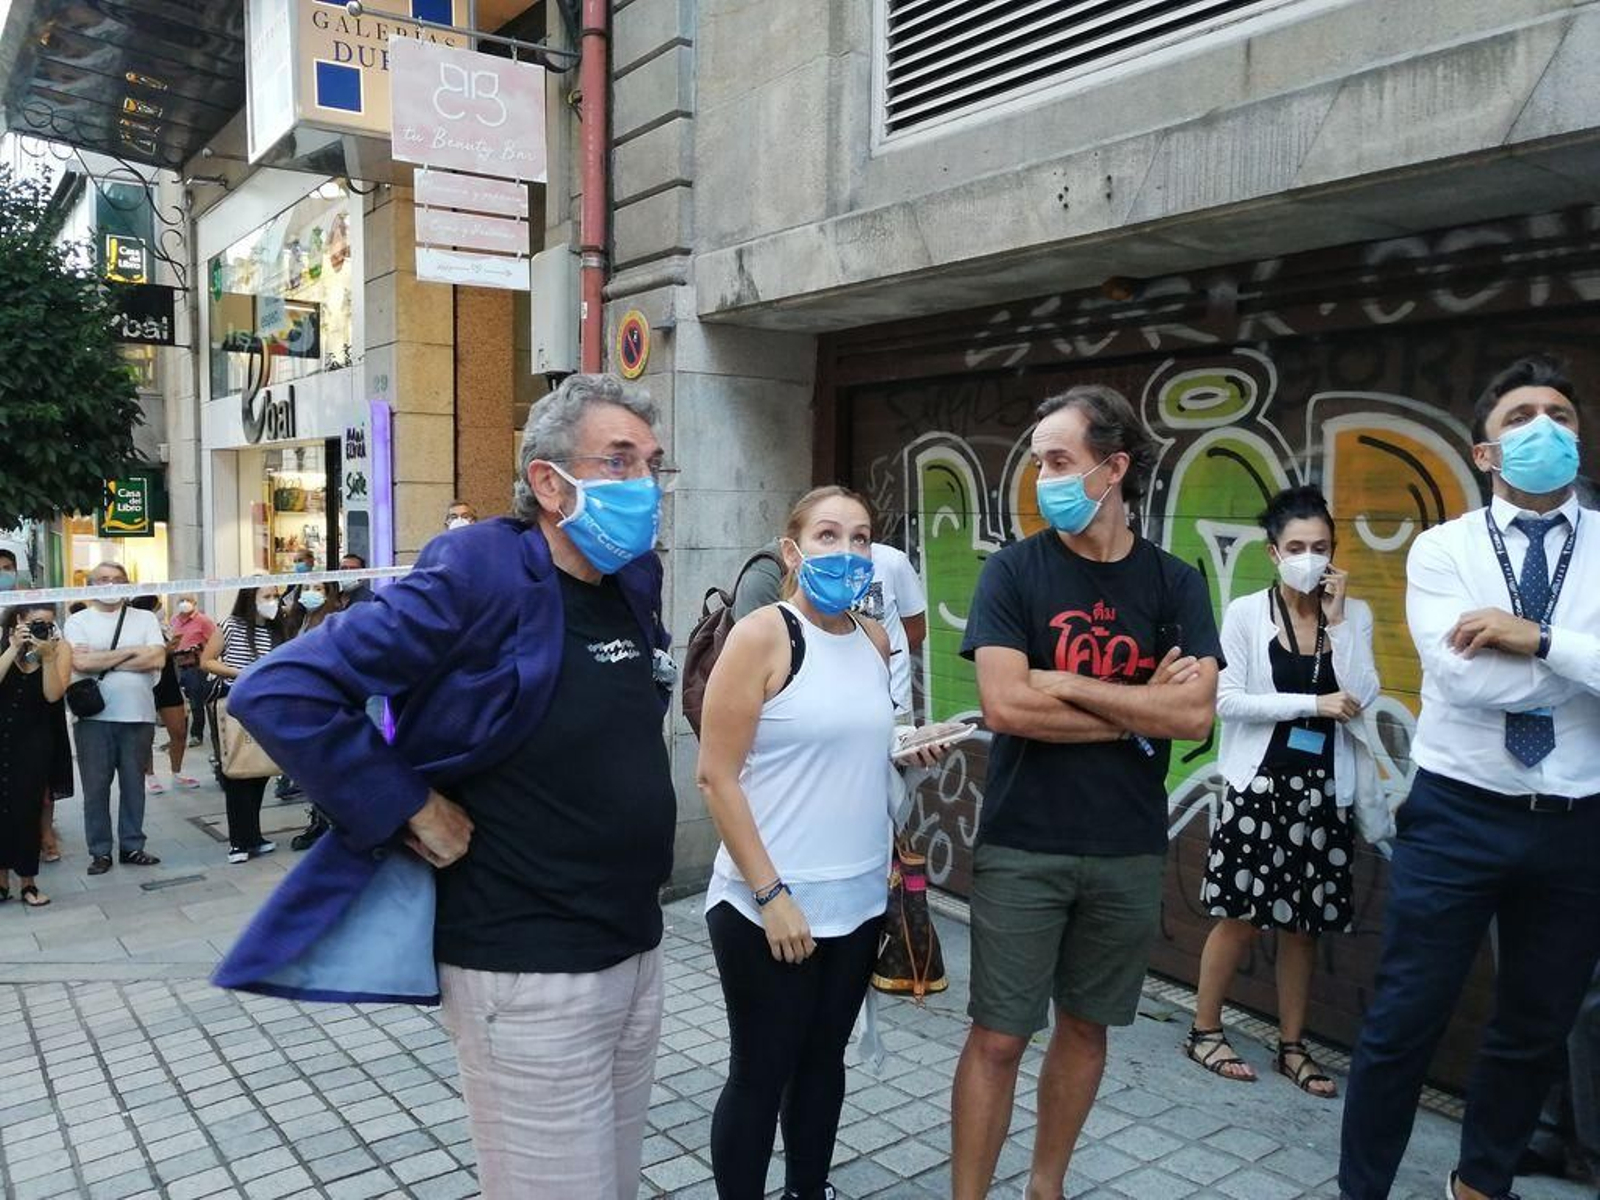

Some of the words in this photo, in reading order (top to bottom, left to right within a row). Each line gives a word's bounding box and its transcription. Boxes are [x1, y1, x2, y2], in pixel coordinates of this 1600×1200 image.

[119, 246, 140, 256] Casa
[118, 259, 141, 270] Libro
[117, 488, 141, 498] Casa
[129, 497, 142, 505] del
[117, 503, 142, 512] Libro
